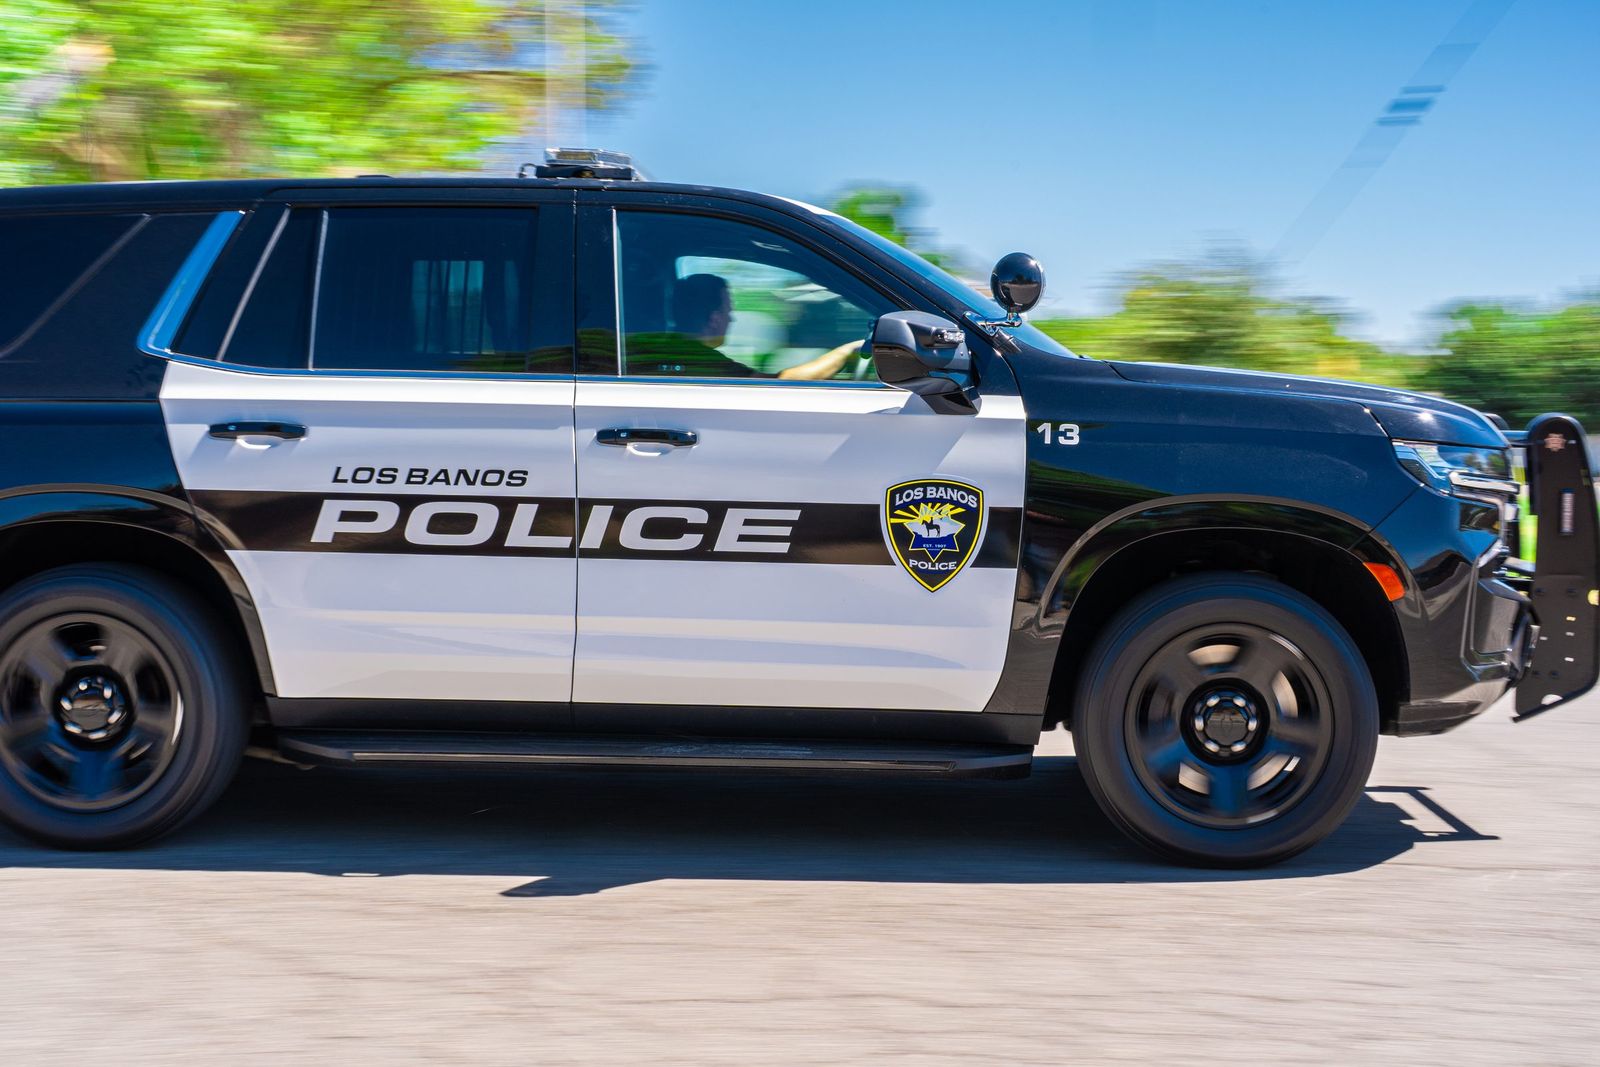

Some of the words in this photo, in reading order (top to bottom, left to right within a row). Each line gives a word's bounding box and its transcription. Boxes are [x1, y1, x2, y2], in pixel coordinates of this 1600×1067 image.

[1036, 422, 1080, 446] 13
[331, 466, 399, 485] LOS
[404, 468, 529, 487] BANOS
[895, 487, 924, 506] LOS
[926, 486, 978, 508] BANOS
[310, 499, 802, 553] POLICE
[909, 558, 957, 571] POLICE
